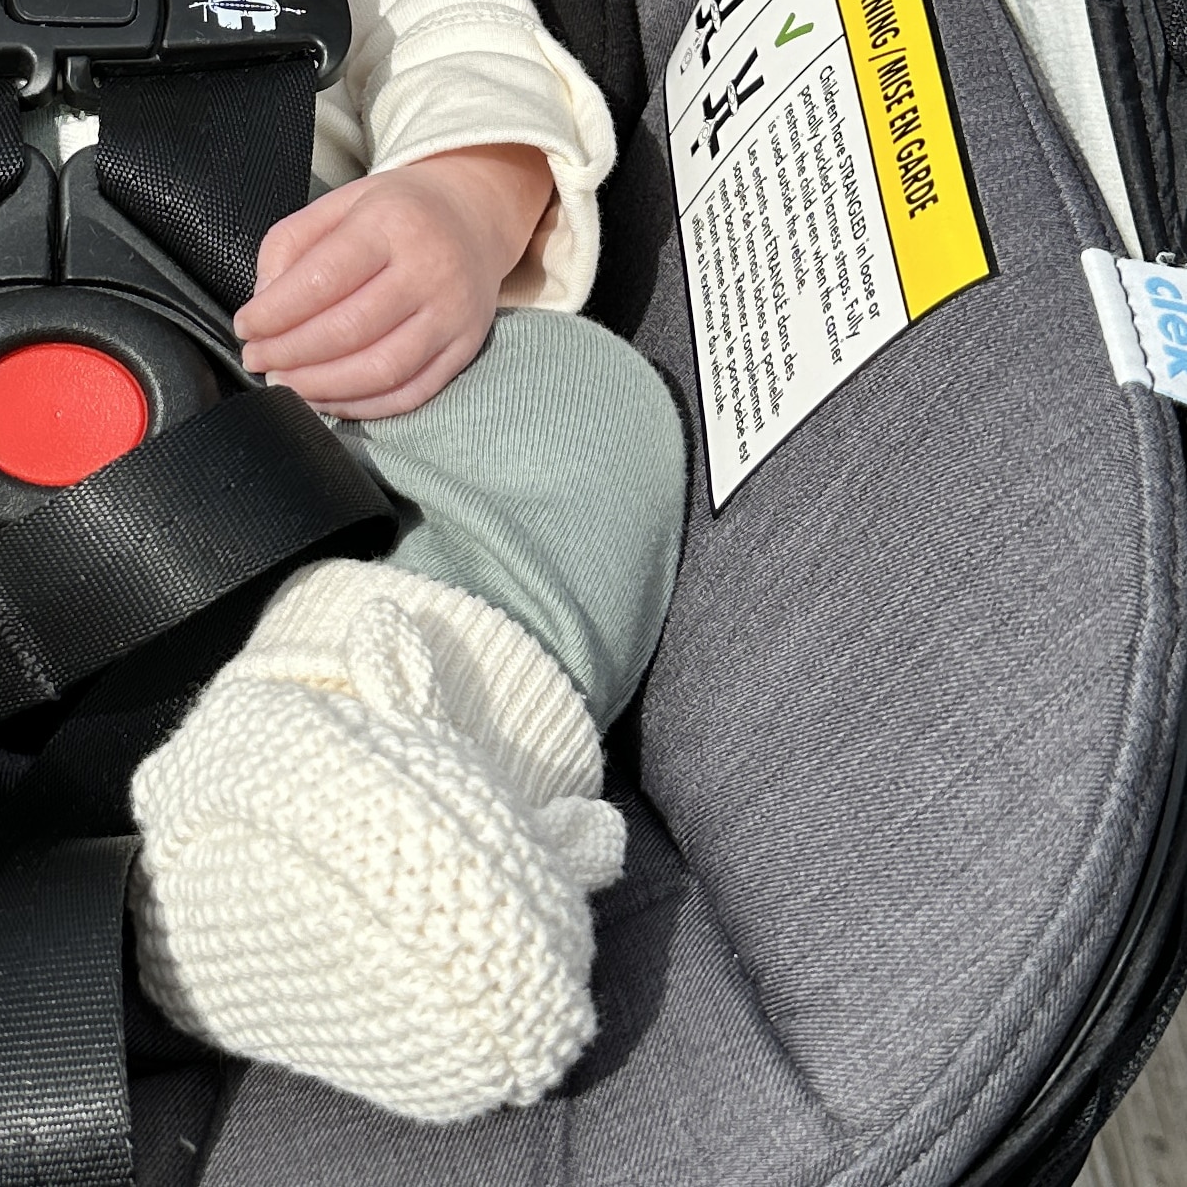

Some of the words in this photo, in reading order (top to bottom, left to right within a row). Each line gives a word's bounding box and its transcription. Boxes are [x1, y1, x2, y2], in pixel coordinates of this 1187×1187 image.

[819, 64, 840, 124] Children
[877, 55, 915, 114] MISE
[767, 115, 780, 135] is
[783, 101, 804, 155] restrain
[796, 84, 824, 142] partially
[889, 105, 924, 144] EN
[747, 138, 759, 167] Les
[770, 132, 789, 168] used
[830, 116, 846, 159] have
[732, 160, 751, 212] sangles
[794, 150, 810, 178] the
[813, 134, 837, 195] buckled
[896, 138, 939, 220] GARDE
[751, 166, 769, 217] enfants
[777, 166, 798, 217] outside
[799, 176, 818, 212] child
[838, 154, 867, 241] STRANGLED
[691, 212, 707, 254] utilisé
[704, 189, 721, 248] l'enfant
[741, 209, 755, 232] de
[760, 215, 774, 241] ont
[785, 213, 801, 241] the
[805, 211, 820, 248] even
[823, 188, 842, 251] harness
[697, 250, 708, 267] à
[712, 245, 726, 290] même
[744, 224, 763, 284] harnais
[790, 238, 810, 296] vehicle.
[812, 244, 829, 289] when
[855, 237, 870, 261] in
[698, 259, 716, 334] l'extérieur
[764, 234, 791, 316] ÉTRANGLÉ
[834, 250, 852, 302] straps.
[859, 253, 876, 302] loose
[718, 177, 733, 214] ment
[733, 270, 749, 333] Retenez
[742, 331, 766, 434] complètement
[719, 283, 732, 343] lorsque
[752, 277, 769, 330] lâches
[819, 285, 835, 315] the
[844, 296, 865, 340] Fully
[868, 301, 881, 320] or
[708, 333, 721, 356] du
[725, 335, 738, 359] le
[760, 330, 771, 352] ou
[776, 313, 792, 353] dans
[824, 314, 845, 366] carrier
[710, 354, 728, 421] véhicule.
[760, 351, 784, 418] partielle-
[783, 352, 798, 382] des
[724, 357, 749, 440] porte-bébé
[738, 440, 751, 465] est
